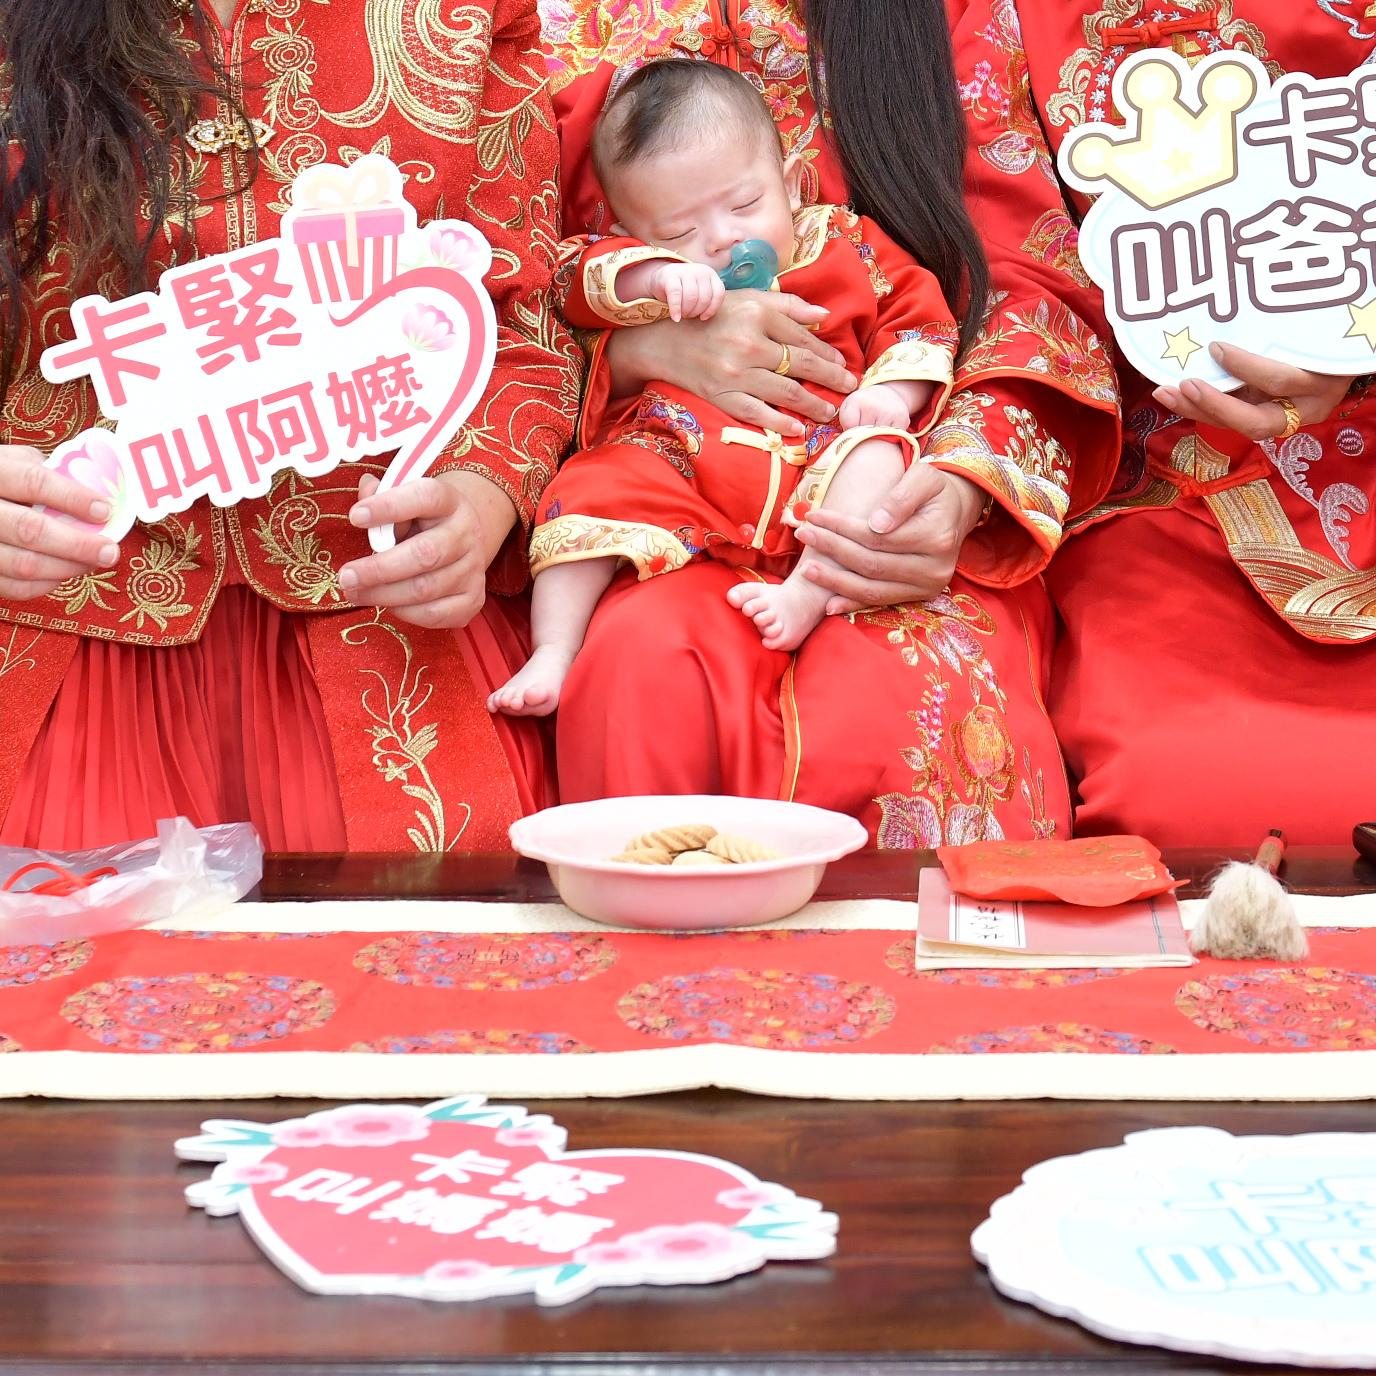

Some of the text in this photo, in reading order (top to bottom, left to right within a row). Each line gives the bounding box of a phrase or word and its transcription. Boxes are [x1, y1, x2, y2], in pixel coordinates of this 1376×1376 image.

[52, 247, 302, 407] 卡緊
[129, 352, 432, 508] 叫阿嬤
[270, 1167, 617, 1252] 叫媽媽
[410, 1149, 624, 1206] 卡緊
